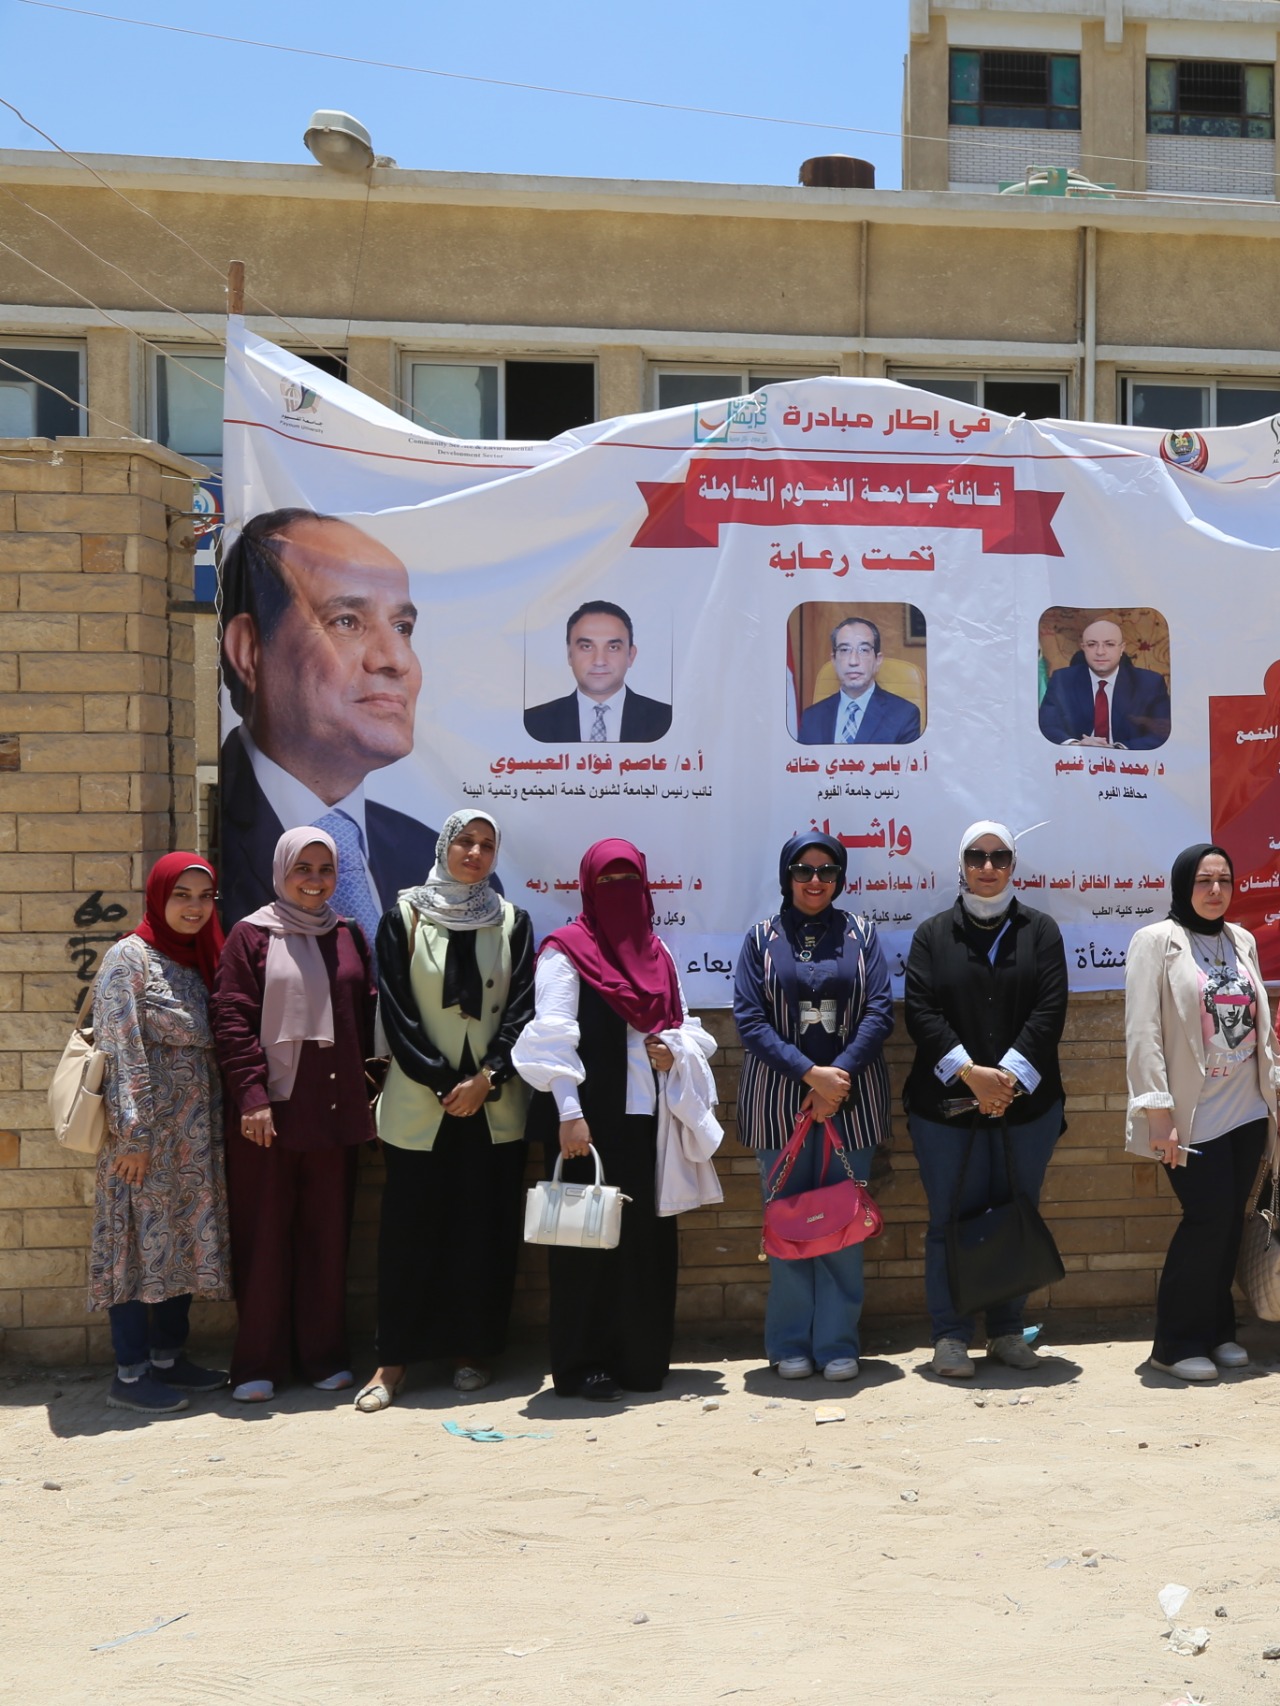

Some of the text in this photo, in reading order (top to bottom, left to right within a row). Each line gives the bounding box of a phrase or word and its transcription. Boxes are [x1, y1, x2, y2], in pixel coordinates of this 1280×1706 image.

[783, 405, 991, 443] في إطار مبادرة
[408, 437, 447, 449] Community
[437, 449, 481, 458] Development
[698, 474, 1002, 510] قافلة جامعة الفيوم الشاملة
[768, 541, 935, 578] تحت رعاية
[1236, 725, 1278, 744] المجتمع
[489, 753, 570, 778] العيسوي
[576, 753, 613, 775] فؤاد
[619, 753, 667, 776] عاصم
[785, 756, 820, 773] حتاته
[825, 757, 865, 780] مجدي
[868, 755, 902, 776] ياسر
[1055, 755, 1084, 776] غنيم
[1119, 760, 1149, 776] محمد
[462, 781, 712, 801] نائب رئيس الجامعة لشئون خدمة المجتمع وتنمية البيئة
[817, 783, 900, 801] رئيس جامعة الفيوم
[1098, 786, 1147, 801] محافظ الفيوم
[526, 877, 579, 894] عبد ربه
[647, 874, 683, 895] نيفي
[844, 875, 862, 896] إبرا
[1012, 870, 1165, 892] نجلاء عبد الخالق أحمد الشري
[663, 911, 686, 926] وكيل
[872, 909, 890, 925] كلية
[893, 911, 912, 924] عميد
[1092, 905, 1154, 919] عميد كلية الطب
[686, 941, 1127, 980] نشأة بعاء
